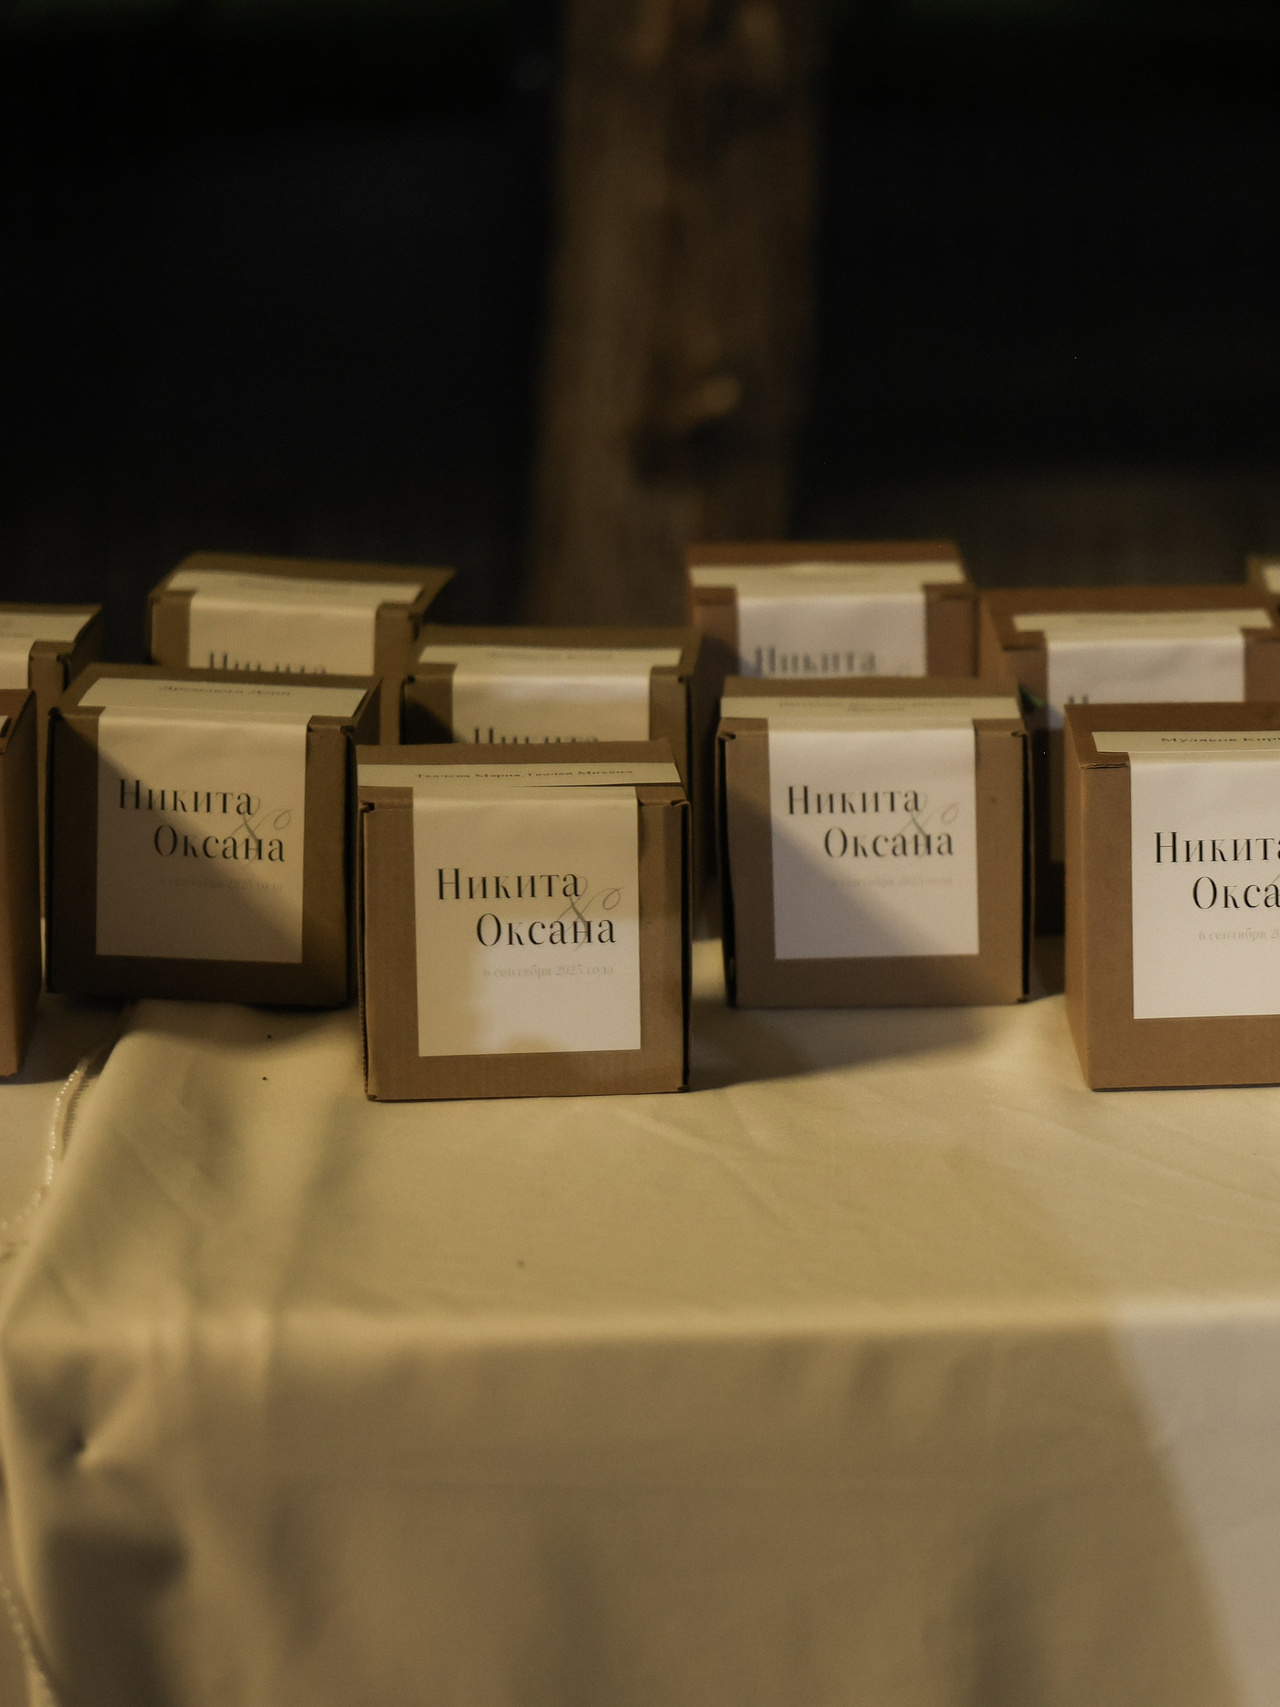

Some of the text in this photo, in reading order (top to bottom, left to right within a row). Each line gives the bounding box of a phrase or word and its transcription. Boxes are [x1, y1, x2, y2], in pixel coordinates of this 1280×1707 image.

[119, 778, 253, 816] Никита
[787, 785, 920, 815] Никита
[153, 824, 285, 863] Оксана
[824, 826, 954, 858] Оксана
[436, 867, 582, 900] Никита
[476, 912, 617, 947] Оксана
[1209, 926, 1267, 943] сентября
[493, 963, 552, 980] сентября
[556, 963, 584, 976] 2025
